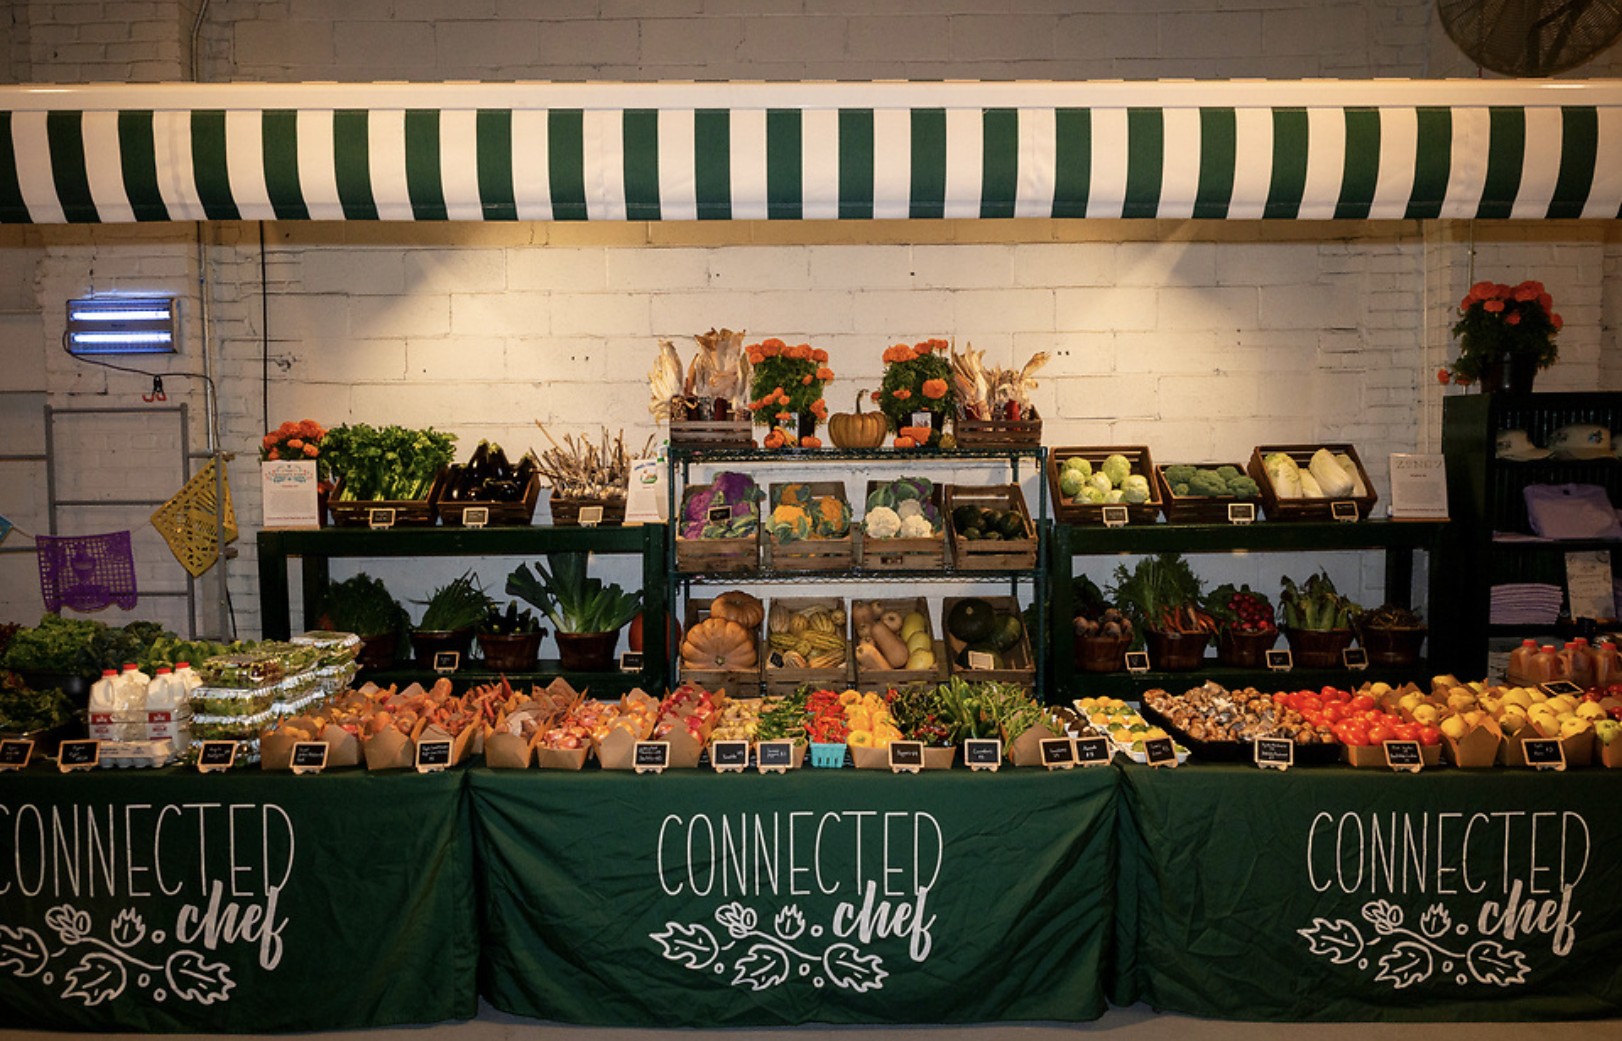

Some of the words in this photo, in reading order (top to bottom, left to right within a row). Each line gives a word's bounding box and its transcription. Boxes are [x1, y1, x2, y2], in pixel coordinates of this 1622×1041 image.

[657, 811, 943, 896] CONNECTED
[1307, 811, 1591, 894] CONNECTED
[176, 879, 290, 971] chef
[832, 880, 937, 962] chef
[1477, 879, 1582, 957] chef
